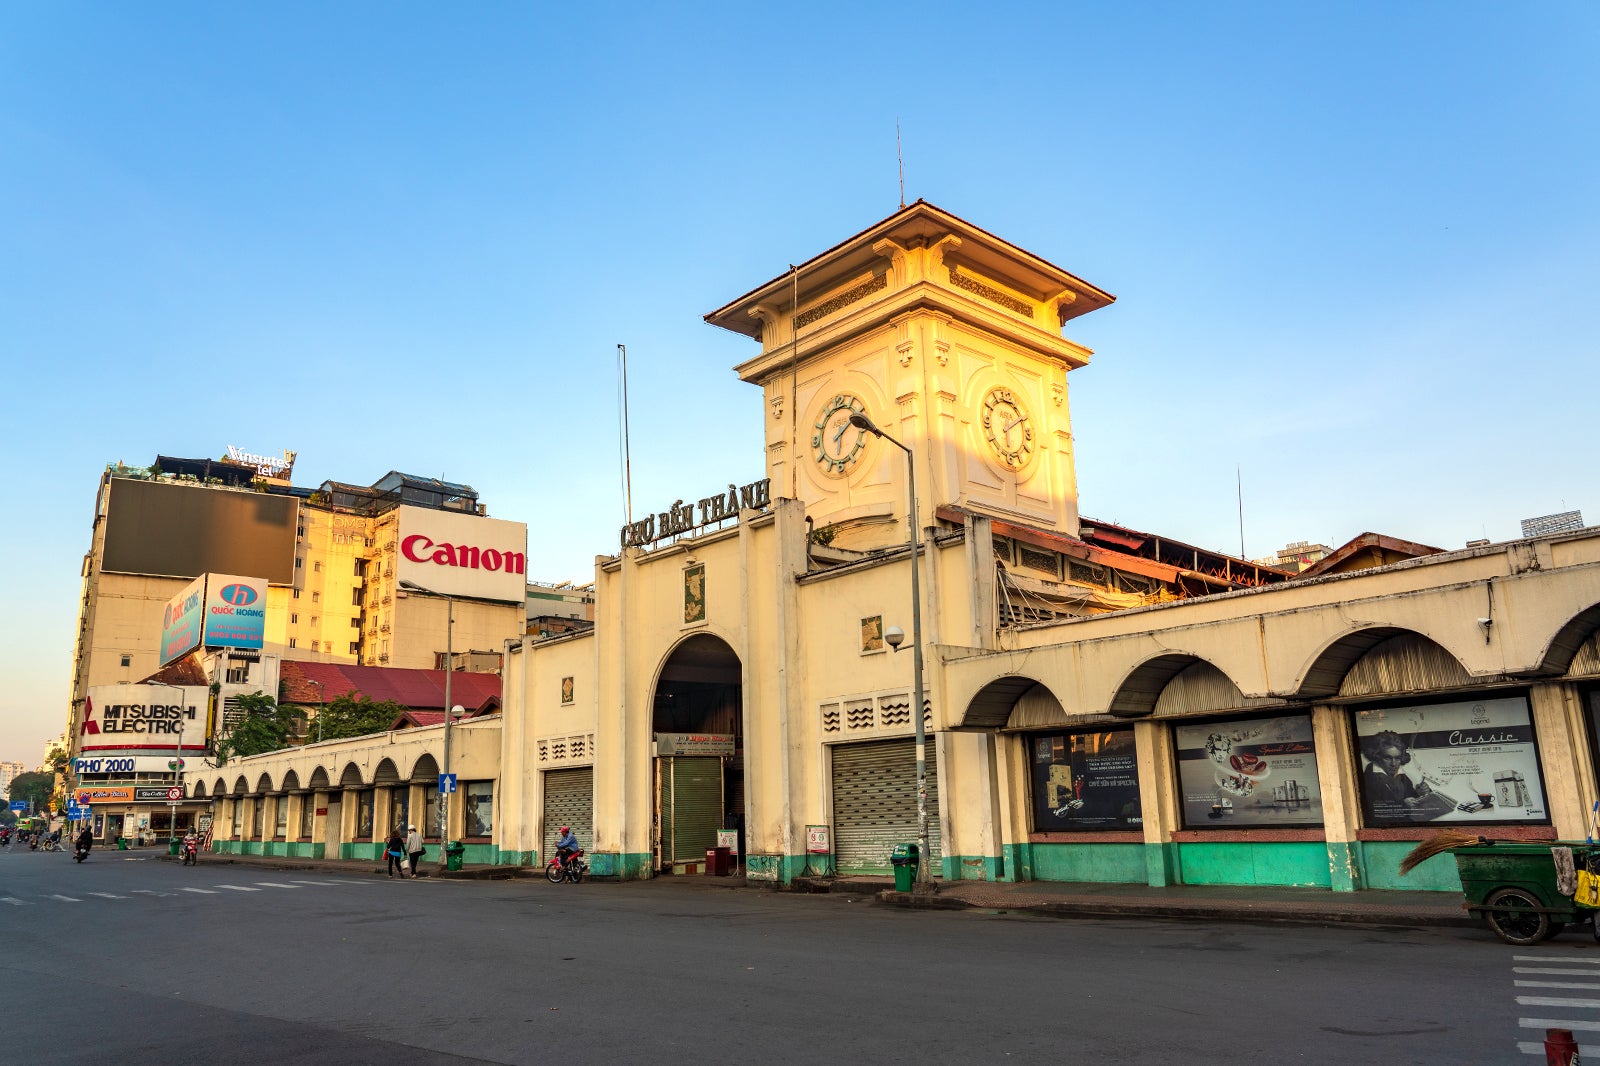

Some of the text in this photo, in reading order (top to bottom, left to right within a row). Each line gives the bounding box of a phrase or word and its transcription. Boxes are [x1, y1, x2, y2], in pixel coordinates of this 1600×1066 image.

[658, 500, 694, 537] BẾN
[698, 478, 771, 525] THÀNH
[401, 533, 525, 575] Canon
[211, 604, 264, 618] QUỐC HOÀNG
[103, 704, 196, 720] MITSUBISHI
[102, 719, 186, 734] ELECTRIC
[1448, 730, 1519, 746] Classic
[105, 758, 135, 773] 2000
